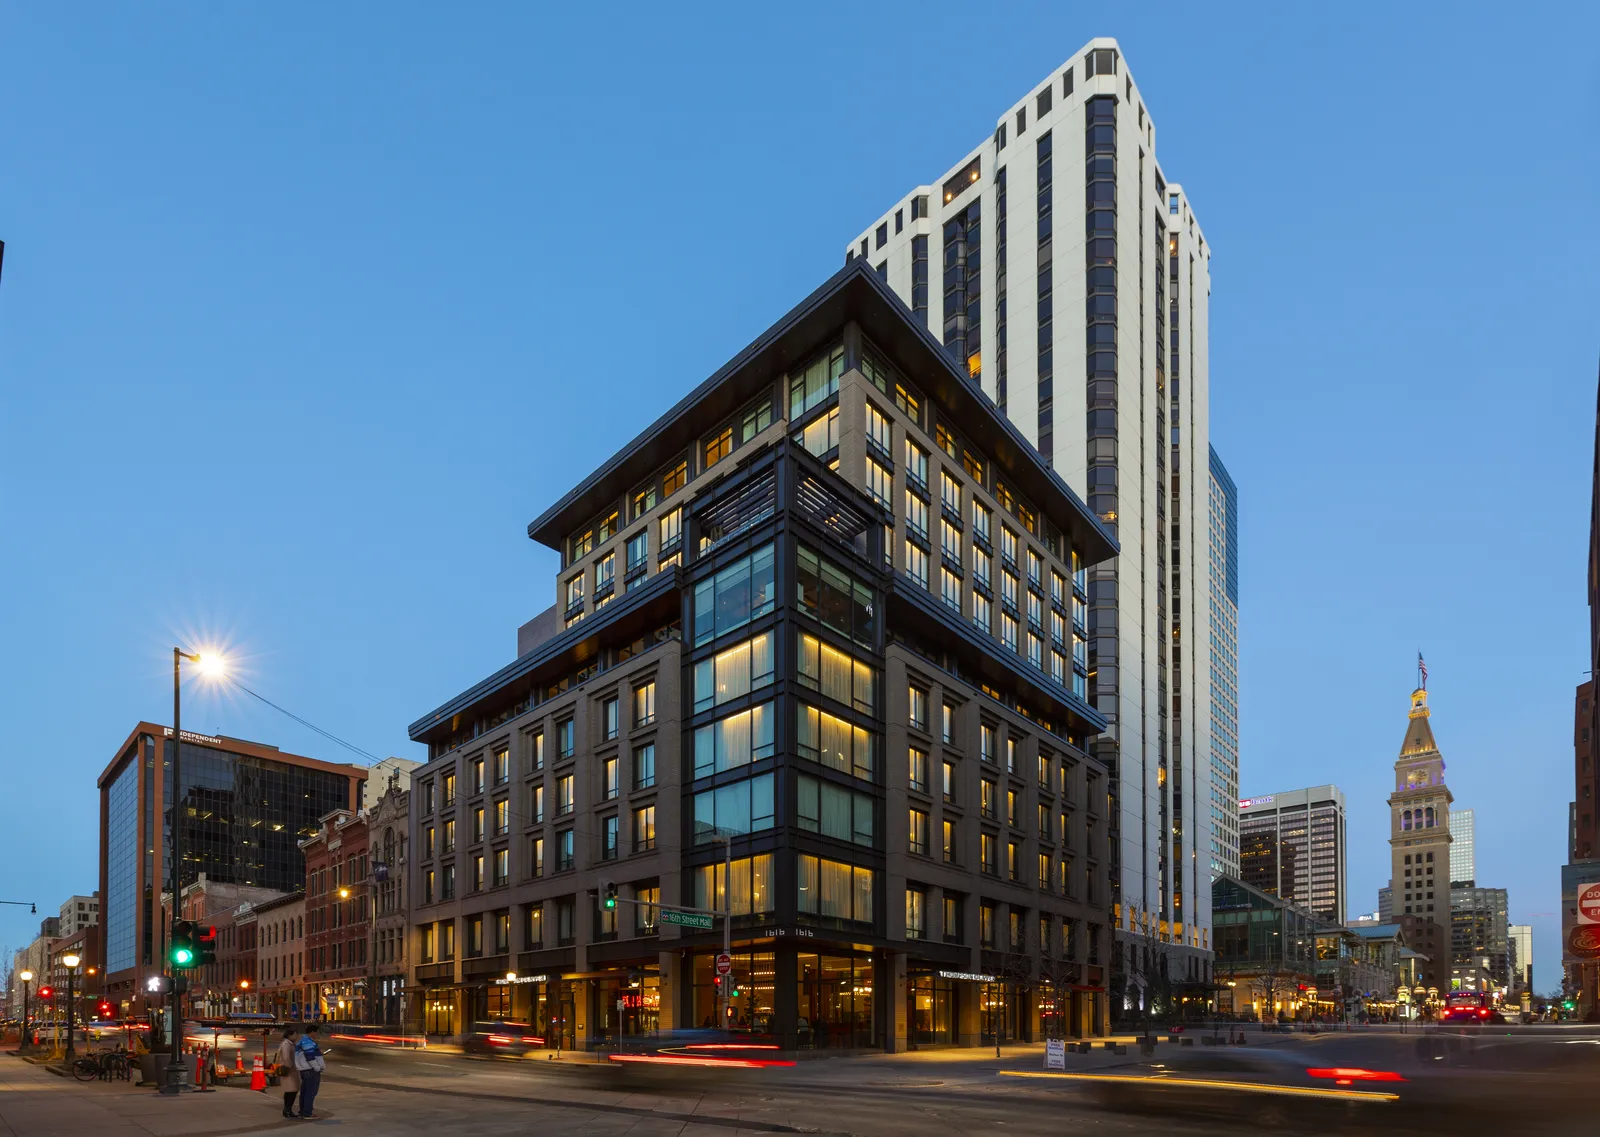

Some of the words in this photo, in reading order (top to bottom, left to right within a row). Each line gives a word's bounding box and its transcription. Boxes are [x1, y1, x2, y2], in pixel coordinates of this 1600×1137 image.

[669, 913, 681, 923] 16th
[681, 915, 699, 926] Street
[699, 917, 713, 927] Mall
